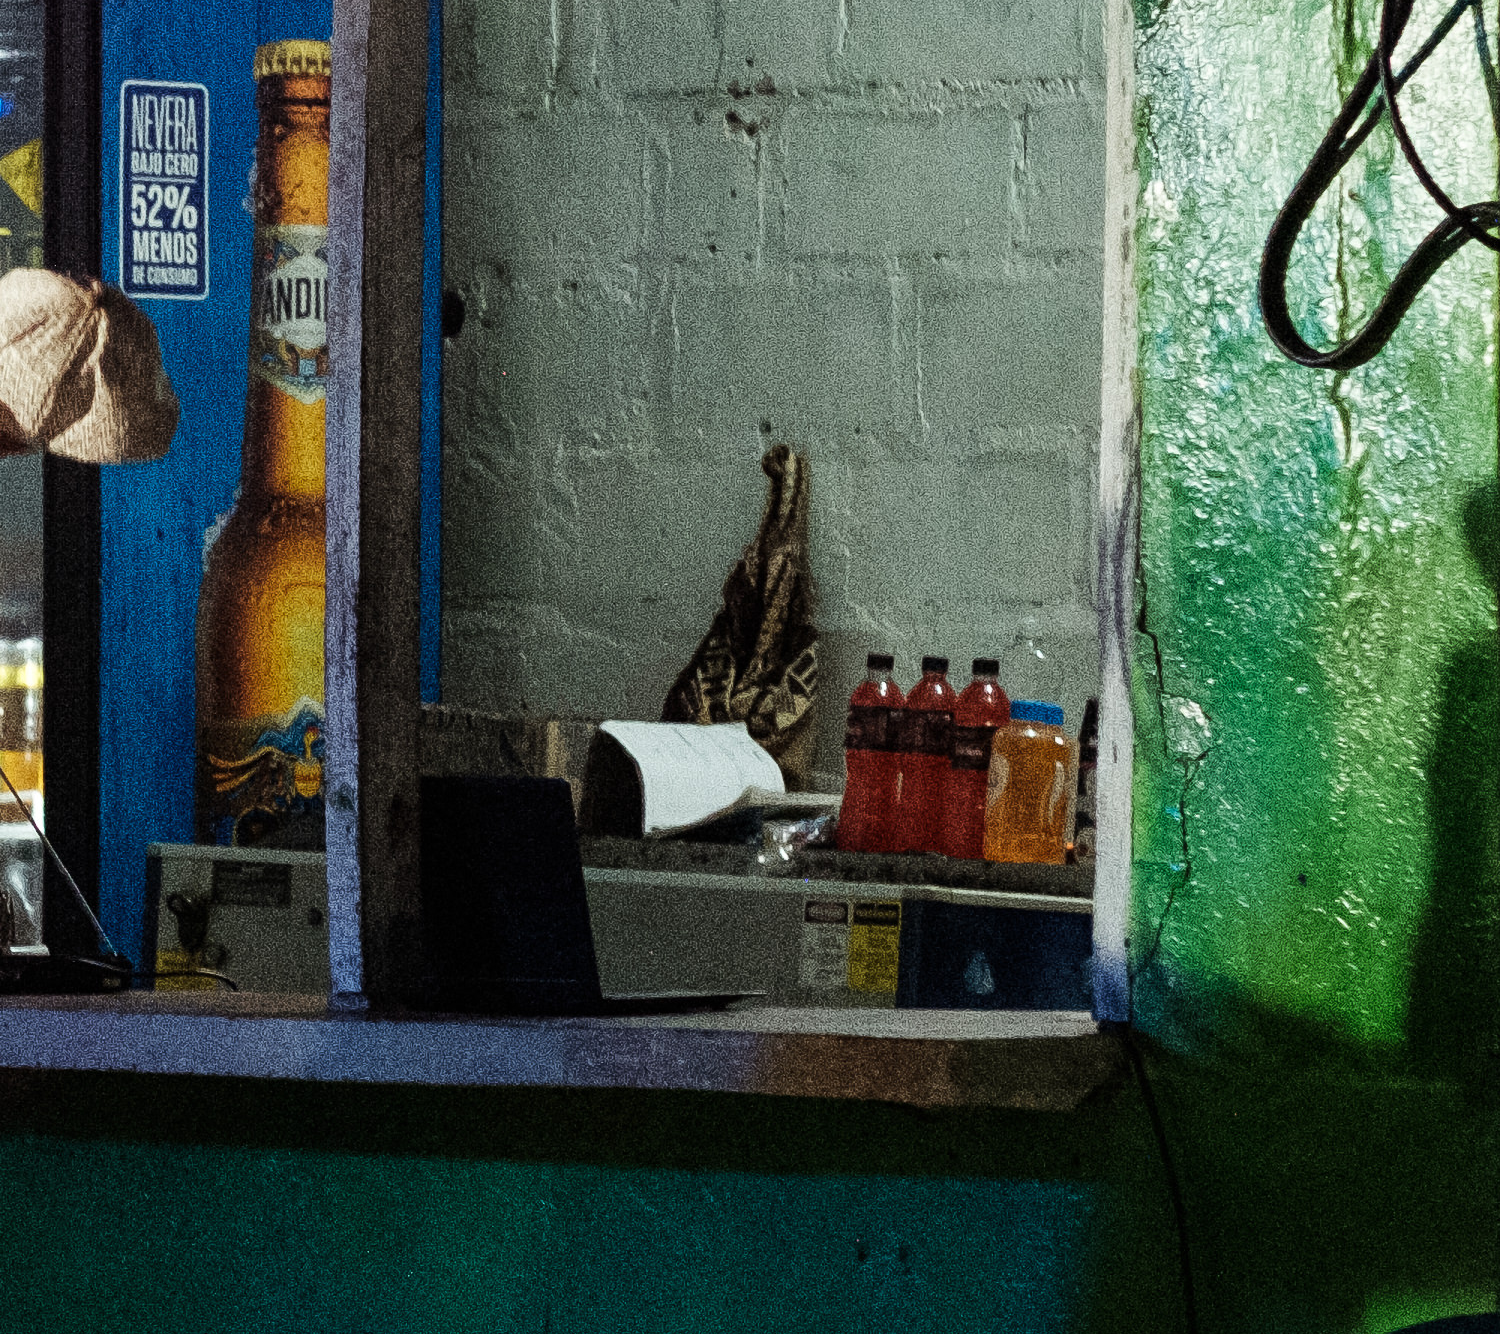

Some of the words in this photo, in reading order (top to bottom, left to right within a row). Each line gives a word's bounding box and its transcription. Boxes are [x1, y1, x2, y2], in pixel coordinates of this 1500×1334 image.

[131, 93, 198, 151] NEVERA
[131, 151, 163, 176] BAJO
[164, 153, 198, 177] CERO
[131, 185, 198, 229] 52%
[132, 231, 198, 265] MENOS
